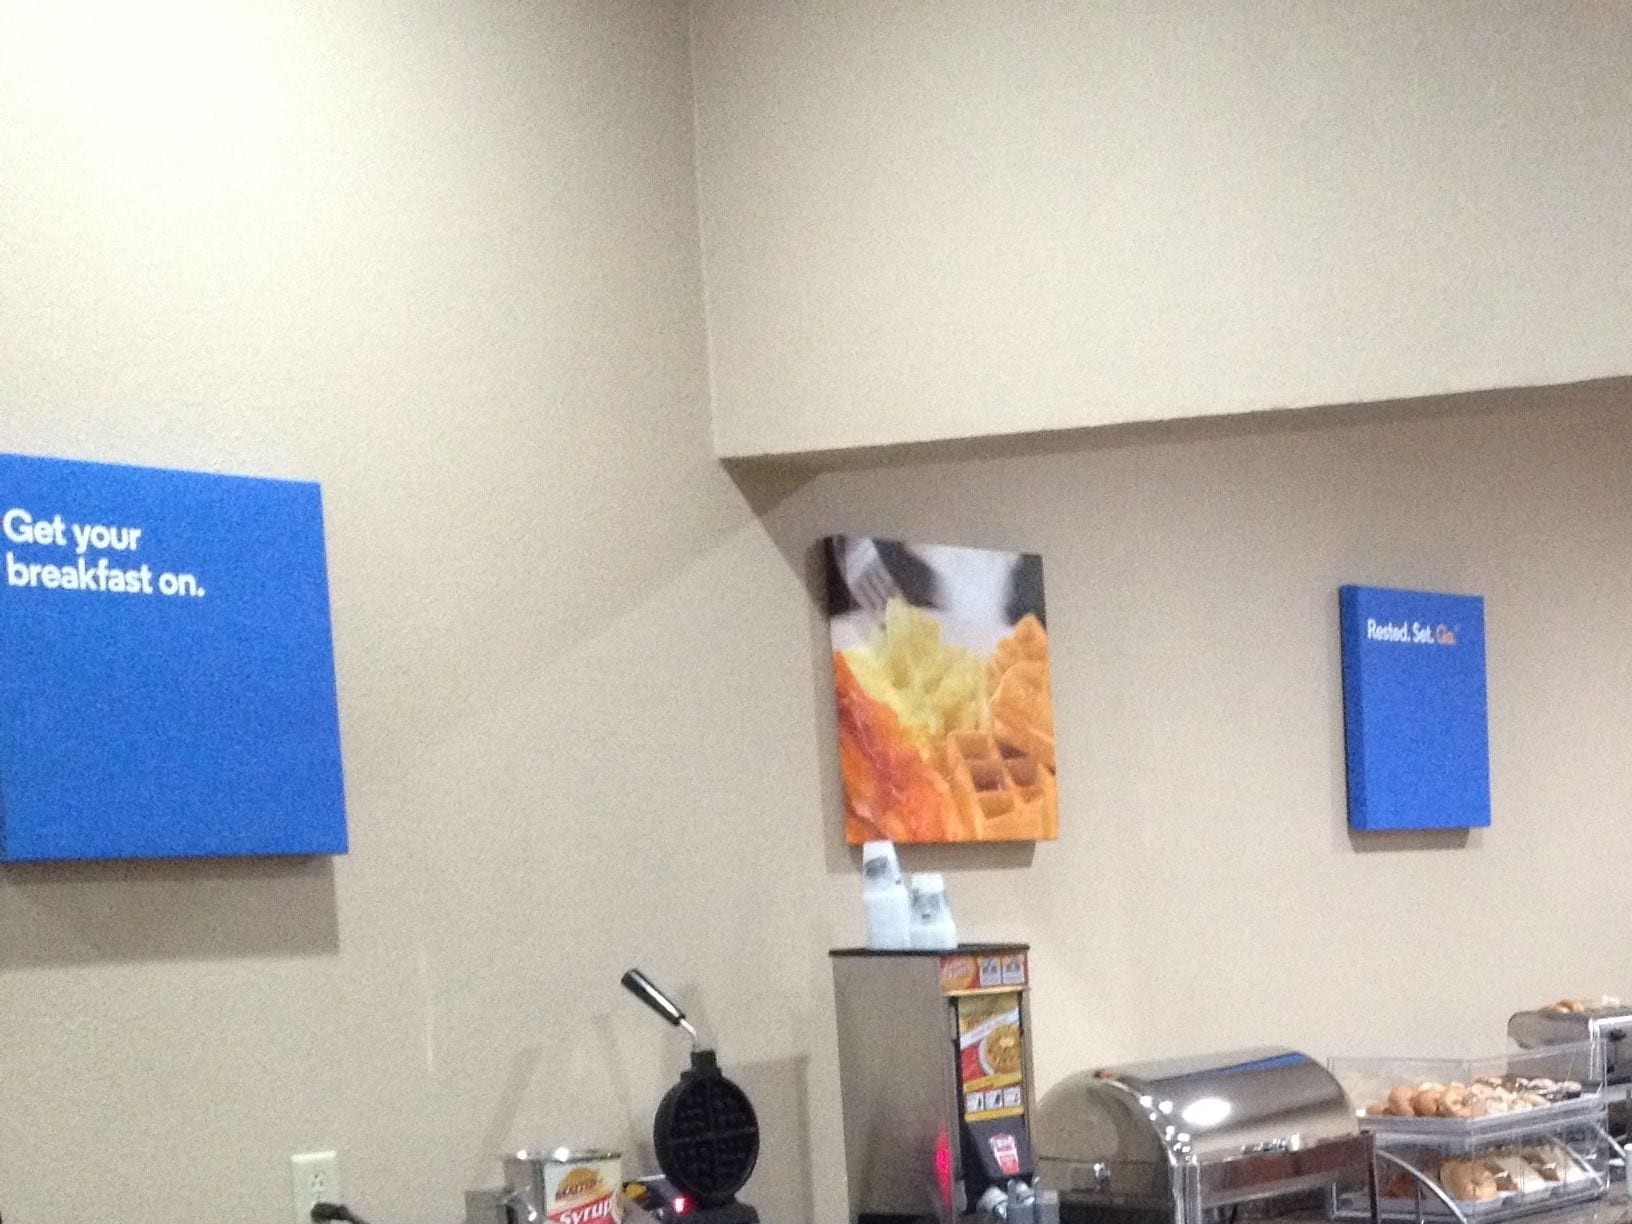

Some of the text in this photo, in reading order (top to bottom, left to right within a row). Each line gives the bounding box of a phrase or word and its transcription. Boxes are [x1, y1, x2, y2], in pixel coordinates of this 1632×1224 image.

[3, 508, 141, 554] Get your
[5, 551, 206, 597] breakfast on.
[1367, 617, 1411, 642] Rested.
[1412, 621, 1435, 643] Set.
